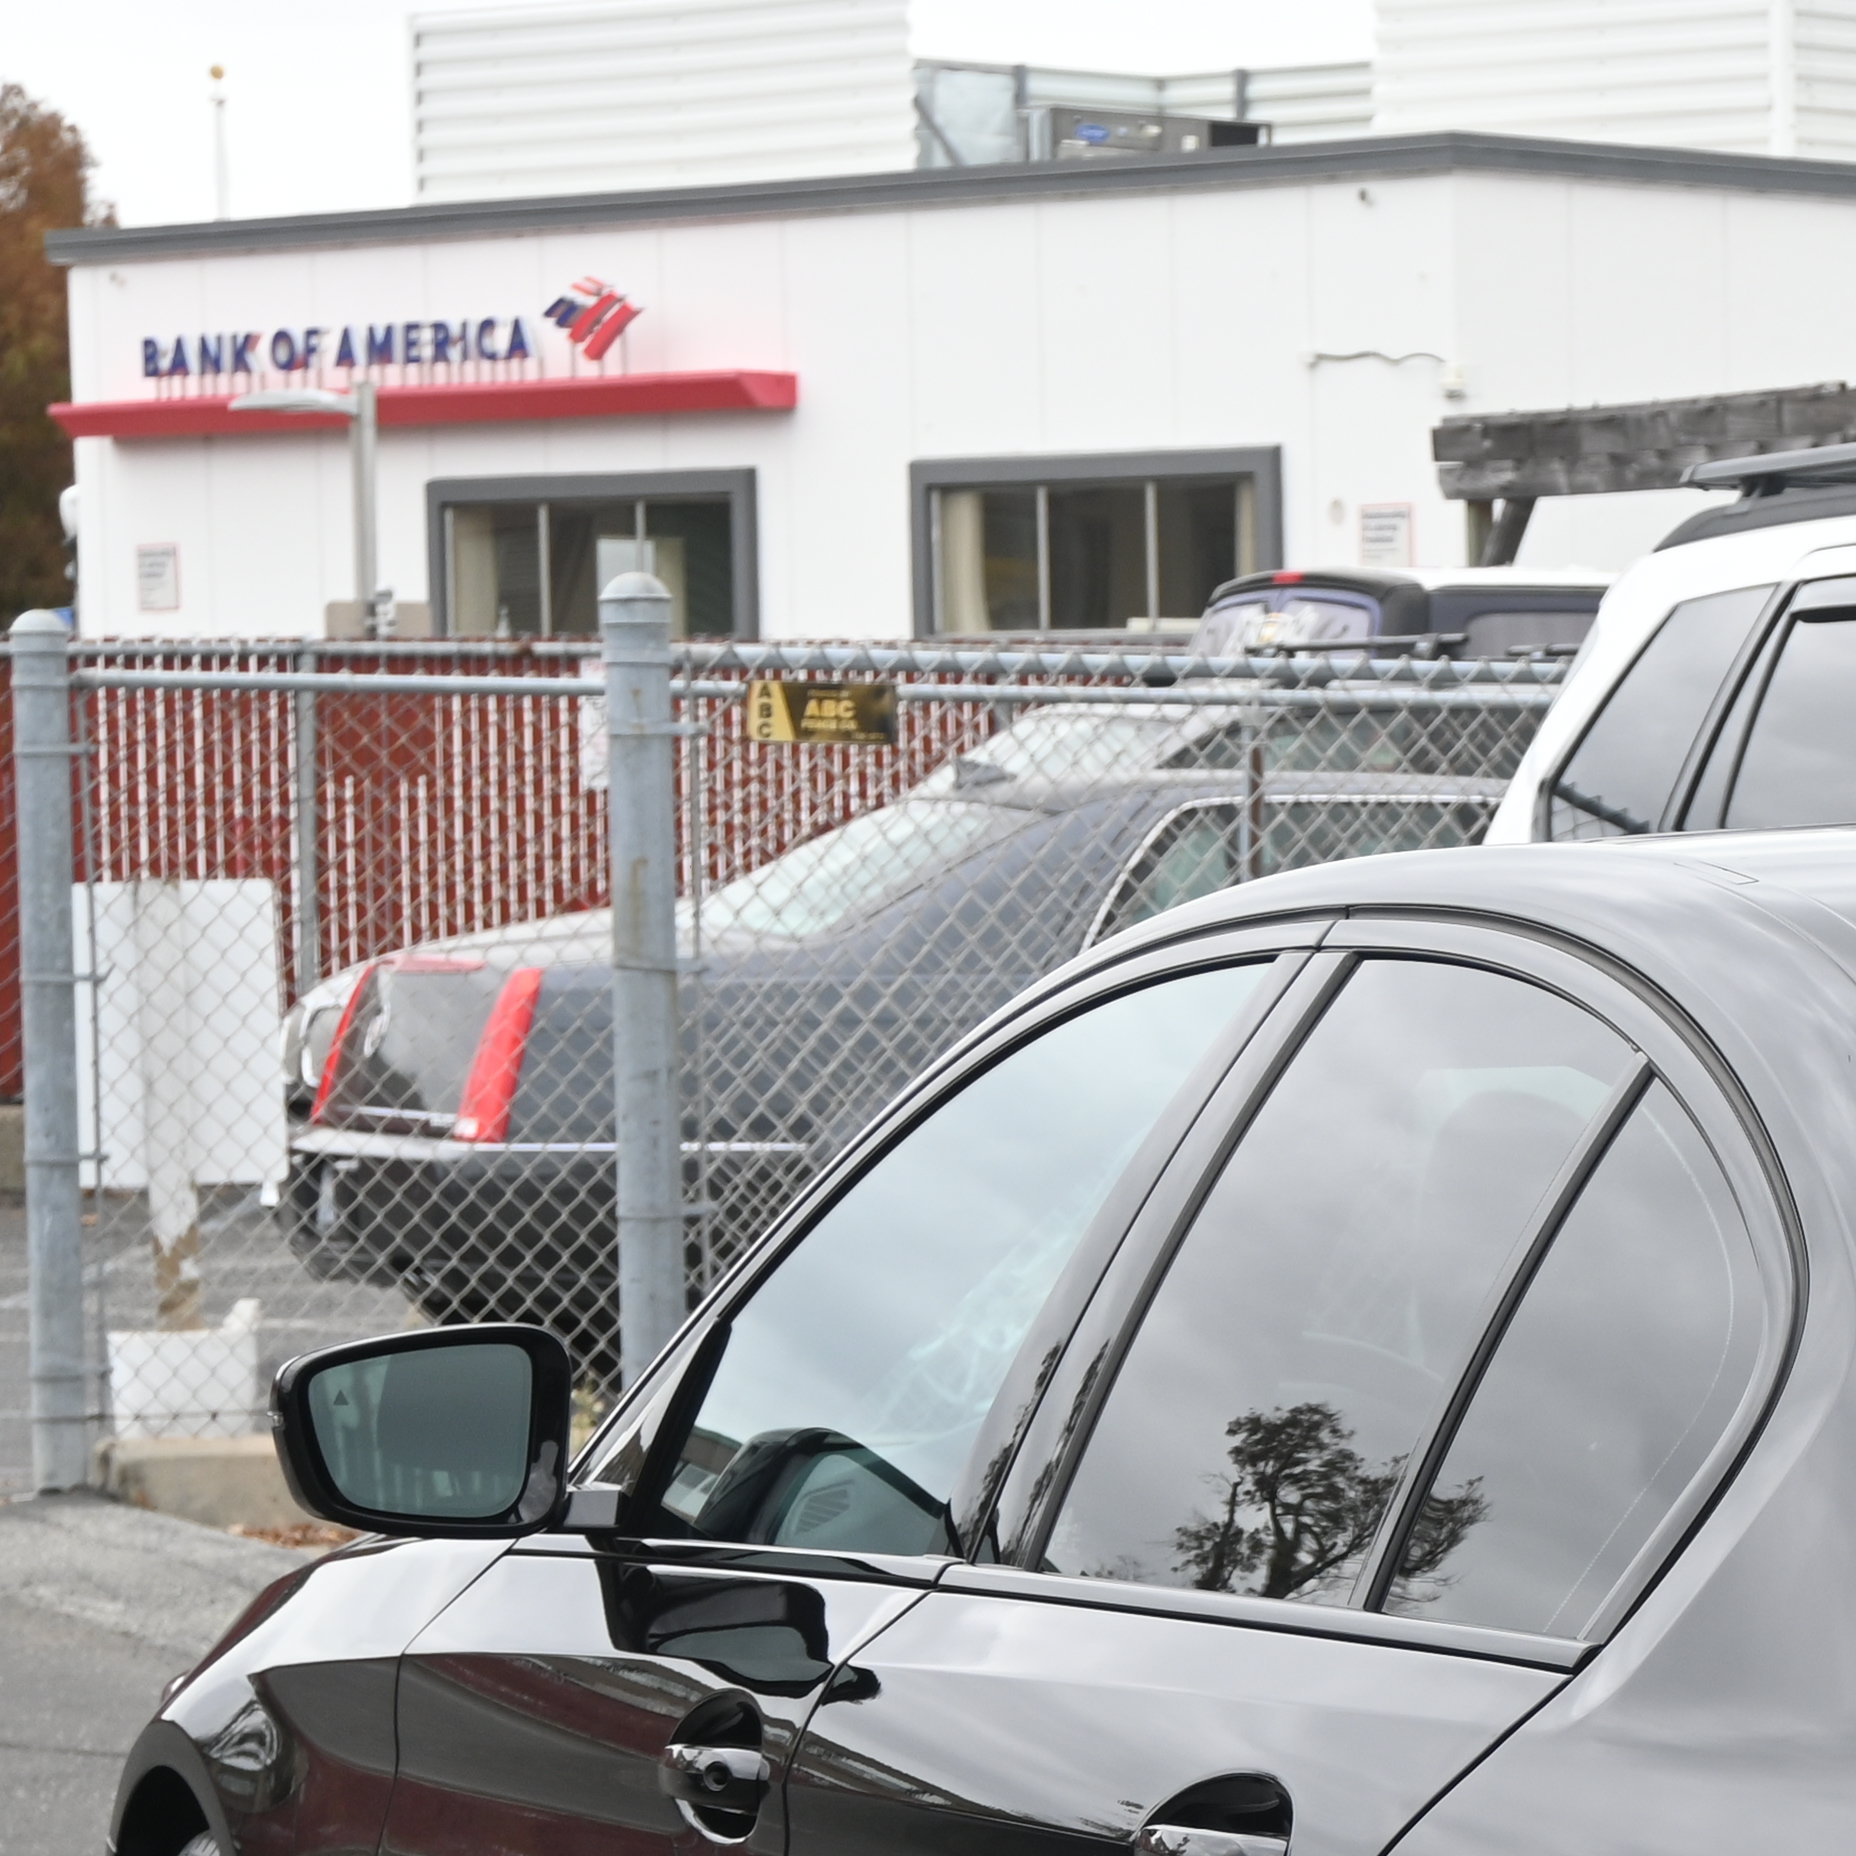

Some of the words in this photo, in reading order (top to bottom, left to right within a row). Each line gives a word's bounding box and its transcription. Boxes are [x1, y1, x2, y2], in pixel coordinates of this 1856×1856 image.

[142, 331, 260, 378] BANK
[271, 328, 322, 372] OF
[336, 316, 532, 367] AMERICA
[803, 699, 857, 718] ABC
